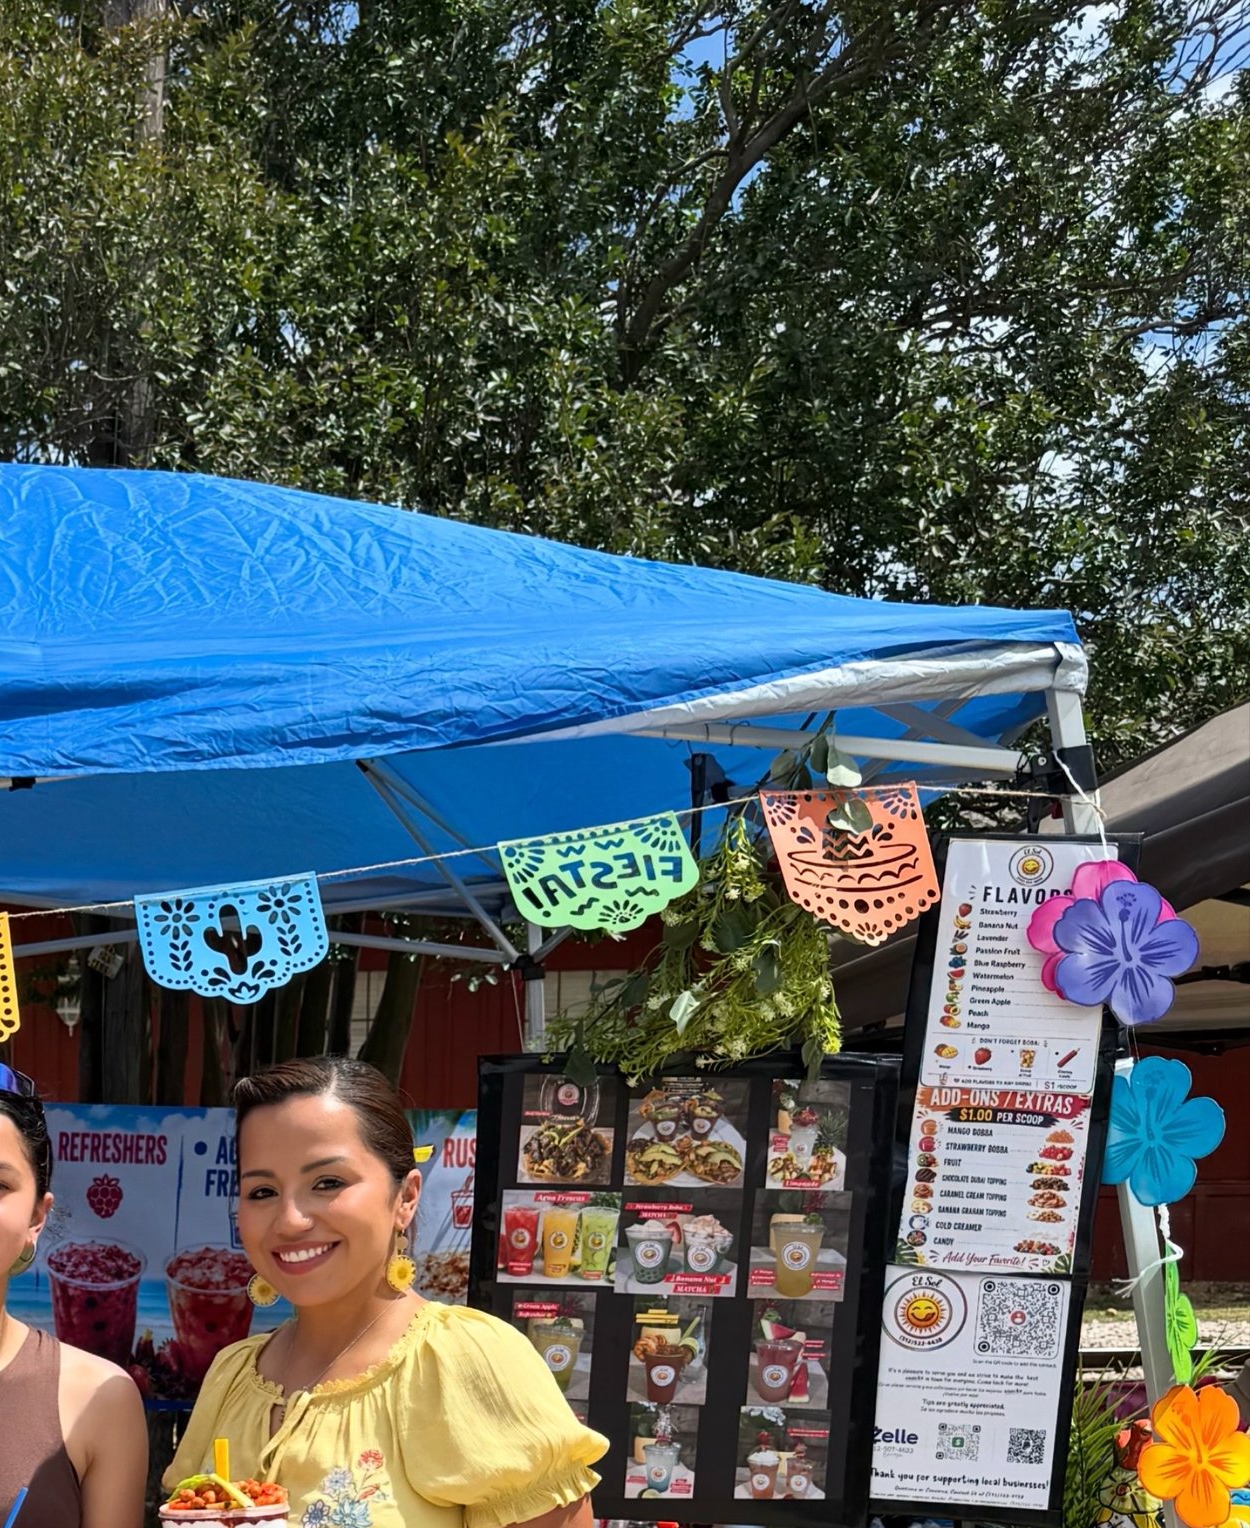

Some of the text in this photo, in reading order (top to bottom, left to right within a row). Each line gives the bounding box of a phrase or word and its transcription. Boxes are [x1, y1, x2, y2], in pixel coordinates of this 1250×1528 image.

[980, 908, 1017, 918] Strawberry
[978, 922, 1018, 930] Banana Nut
[977, 934, 1009, 942] Lavender
[975, 947, 1003, 955] Passion
[991, 960, 1026, 969] Raspberry
[972, 972, 1014, 980] Watermelon
[971, 985, 1005, 994] Pineapple
[991, 998, 1011, 1006] Apple
[967, 1022, 990, 1031] Mango
[930, 1089, 999, 1106] ADD-ONS
[1015, 1092, 1073, 1114] EXTRAS
[959, 1108, 1044, 1125] $1.00 PER SCOOP
[947, 1127, 993, 1137] MANGO BOBBA
[58, 1131, 167, 1165] REFRESHERS
[443, 1137, 476, 1168] RUS
[945, 1142, 1008, 1154] STRAWBERRY BOBBA
[943, 1158, 962, 1166] FRUIT
[942, 1174, 969, 1183] CHOCOLATE
[987, 1177, 1007, 1186] TOPPING
[940, 1190, 1007, 1201] CARAMEL CREAM TOPPING
[938, 1205, 1007, 1217] BANANA GRAHAM TOPPING
[935, 1221, 982, 1231] COLD CREAMER
[933, 1236, 954, 1246] CANDY
[942, 1251, 1025, 1265] Add Your Favorite!
[912, 1276, 943, 1288] El Sol
[922, 1399, 936, 1407] Tips
[948, 1401, 968, 1410] greatly
[970, 1402, 1005, 1411] appreciated.
[872, 1426, 918, 1445] Zelle
[870, 1467, 1049, 1490] Thank you for supporting local businesses!
